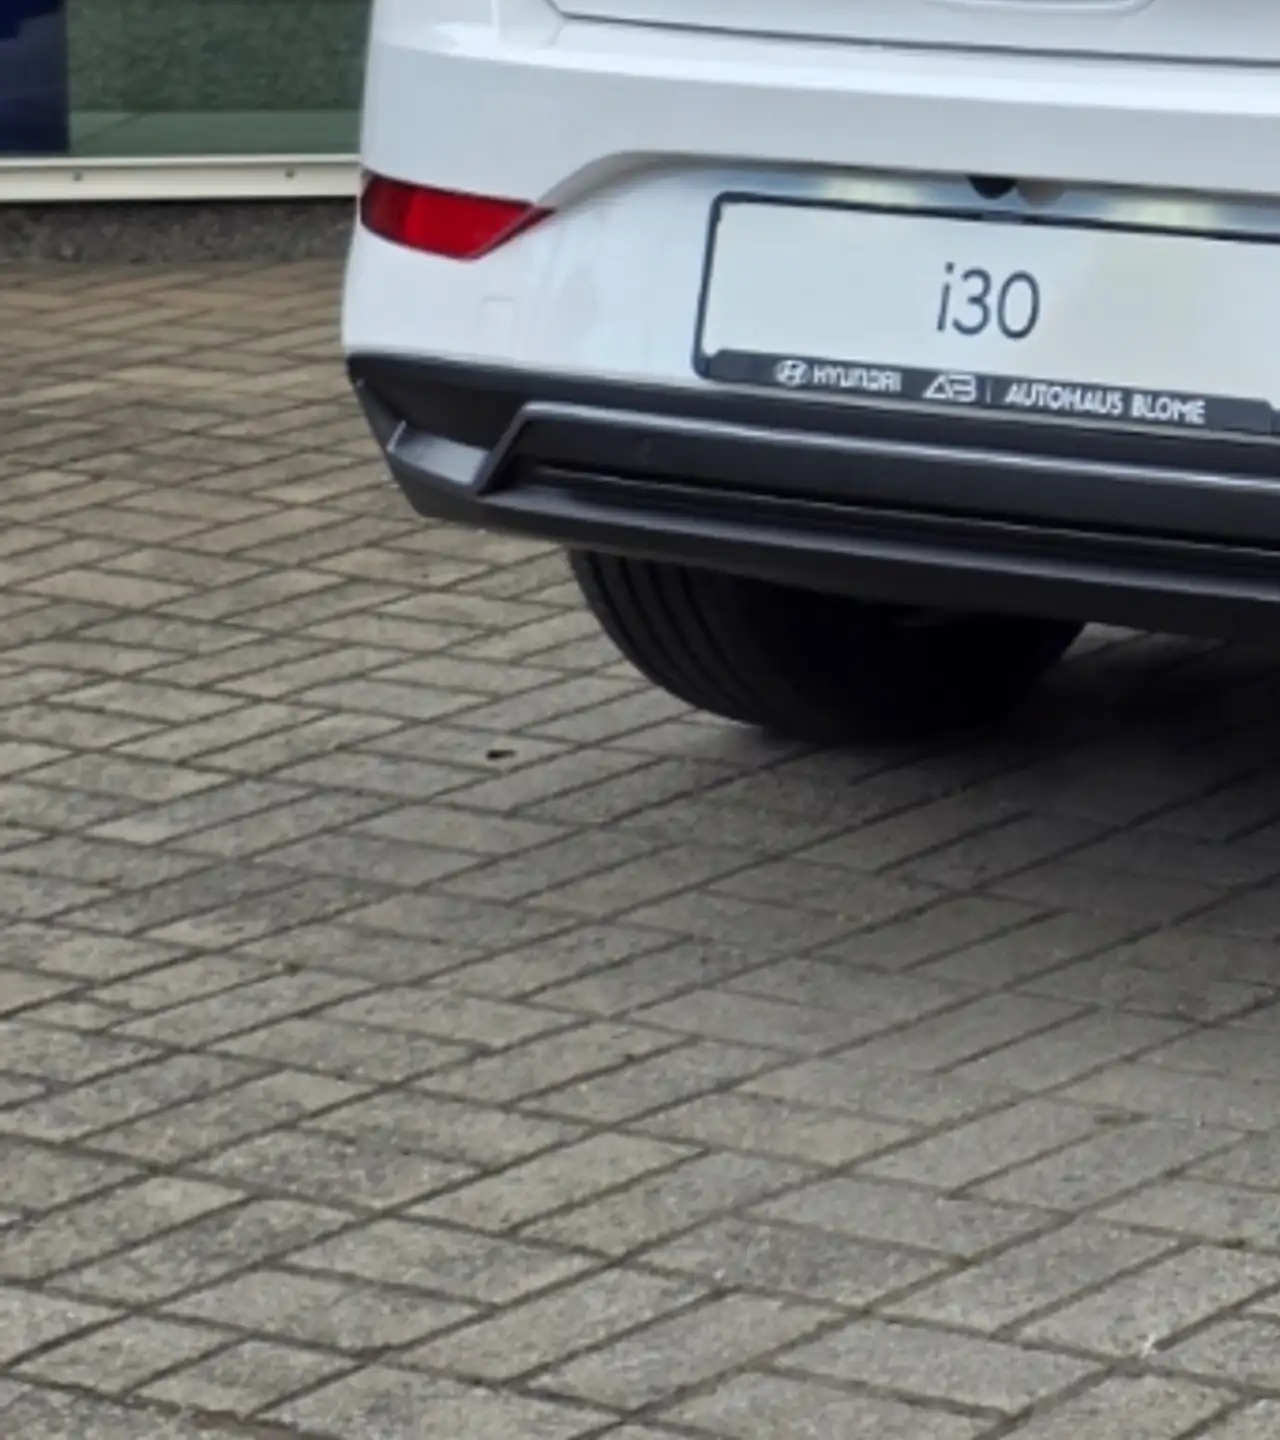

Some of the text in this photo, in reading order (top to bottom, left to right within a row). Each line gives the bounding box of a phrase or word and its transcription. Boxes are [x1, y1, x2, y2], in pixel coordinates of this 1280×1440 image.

[936, 263, 1041, 340] i30
[812, 364, 902, 393] HYUNDAI
[1004, 382, 1123, 416] AUTOHAUS
[1130, 399, 1207, 426] BLOME
